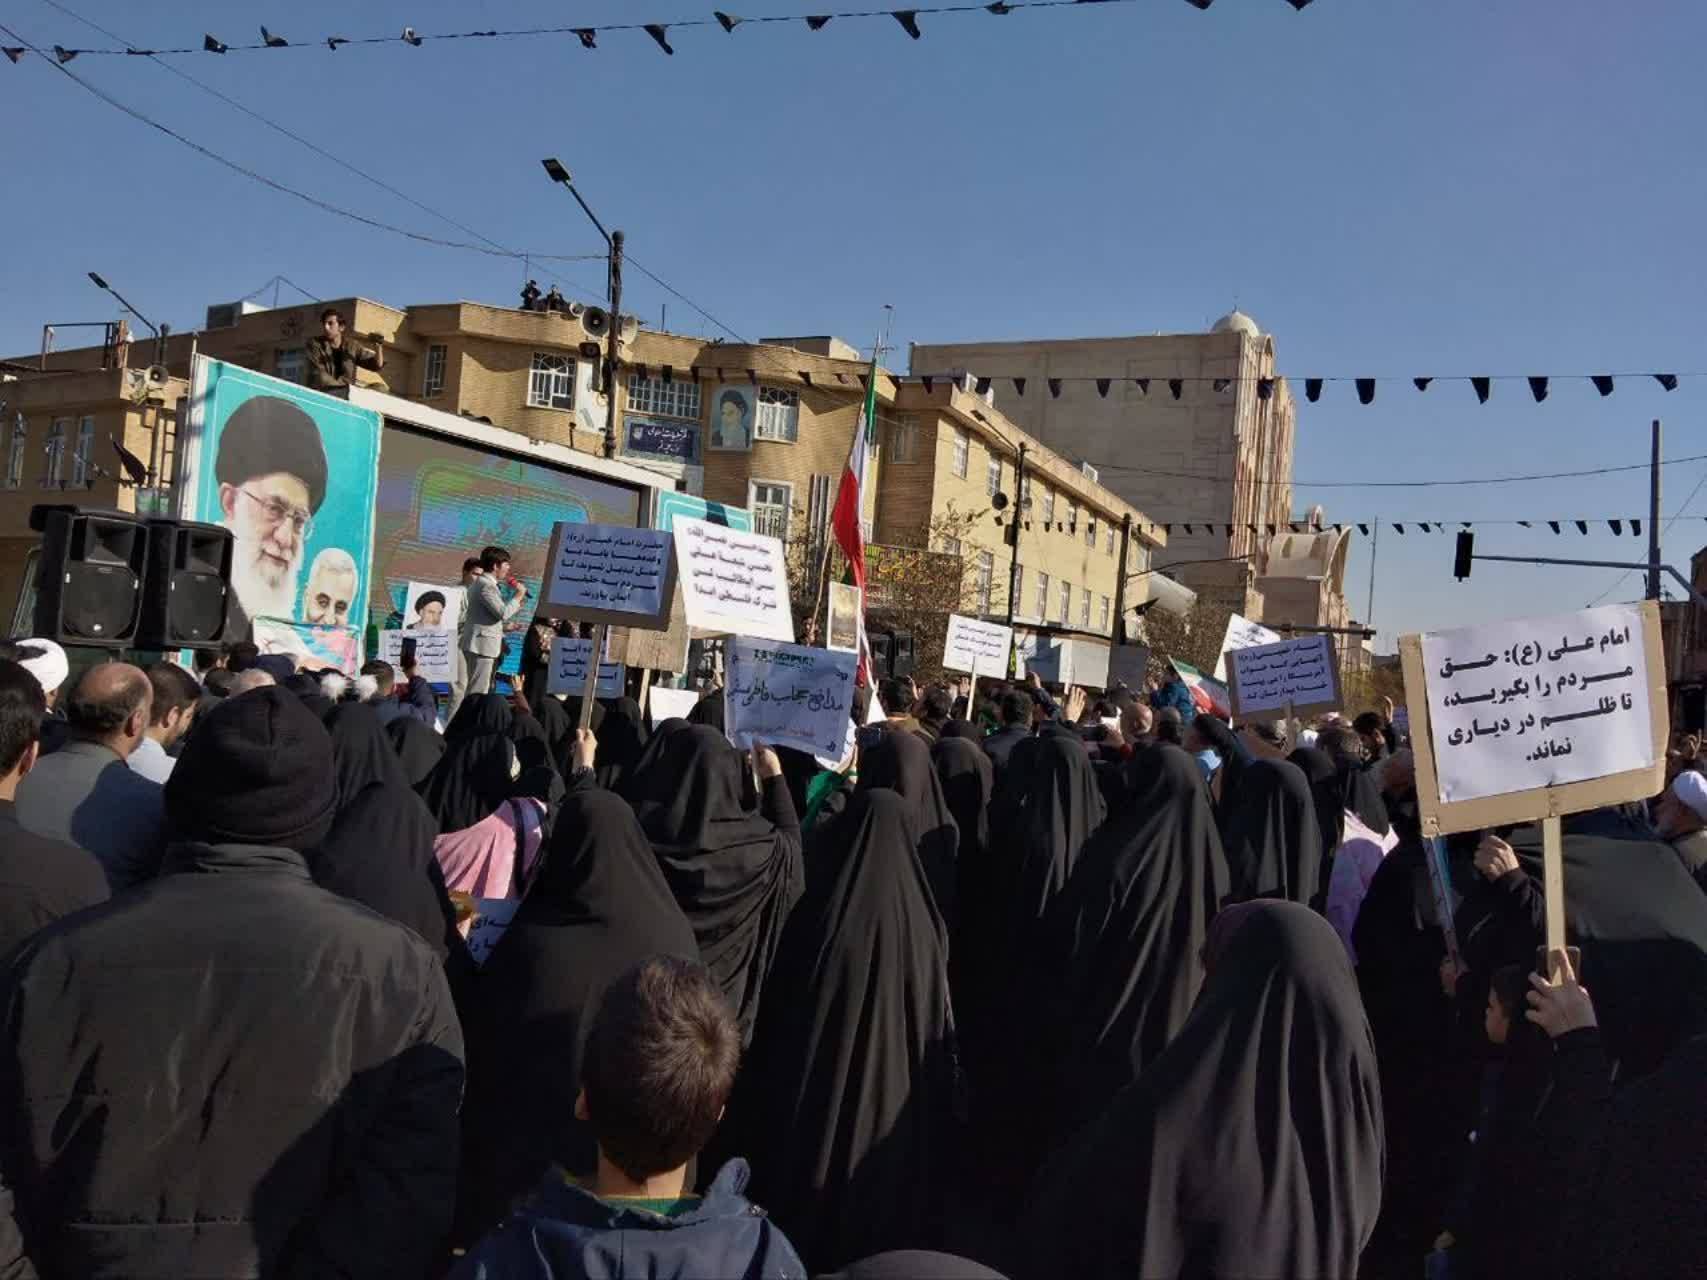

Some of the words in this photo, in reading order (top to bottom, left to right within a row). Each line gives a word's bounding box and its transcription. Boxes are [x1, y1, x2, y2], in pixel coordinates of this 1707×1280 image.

[1547, 636, 1595, 662] علی
[1599, 626, 1630, 653] امام
[1440, 652, 1498, 679] حق
[1504, 641, 1542, 666] (ع):
[1535, 674, 1550, 697] را
[1555, 664, 1634, 694] مردم
[771, 684, 810, 705] حجاب
[808, 687, 844, 712] مدافع
[1443, 677, 1529, 708] بگیرید،
[1621, 692, 1633, 711] تا
[1516, 714, 1535, 735] در
[1540, 697, 1618, 731] ظلم
[1447, 718, 1511, 746] دیاری
[1525, 737, 1573, 762] نماند.
